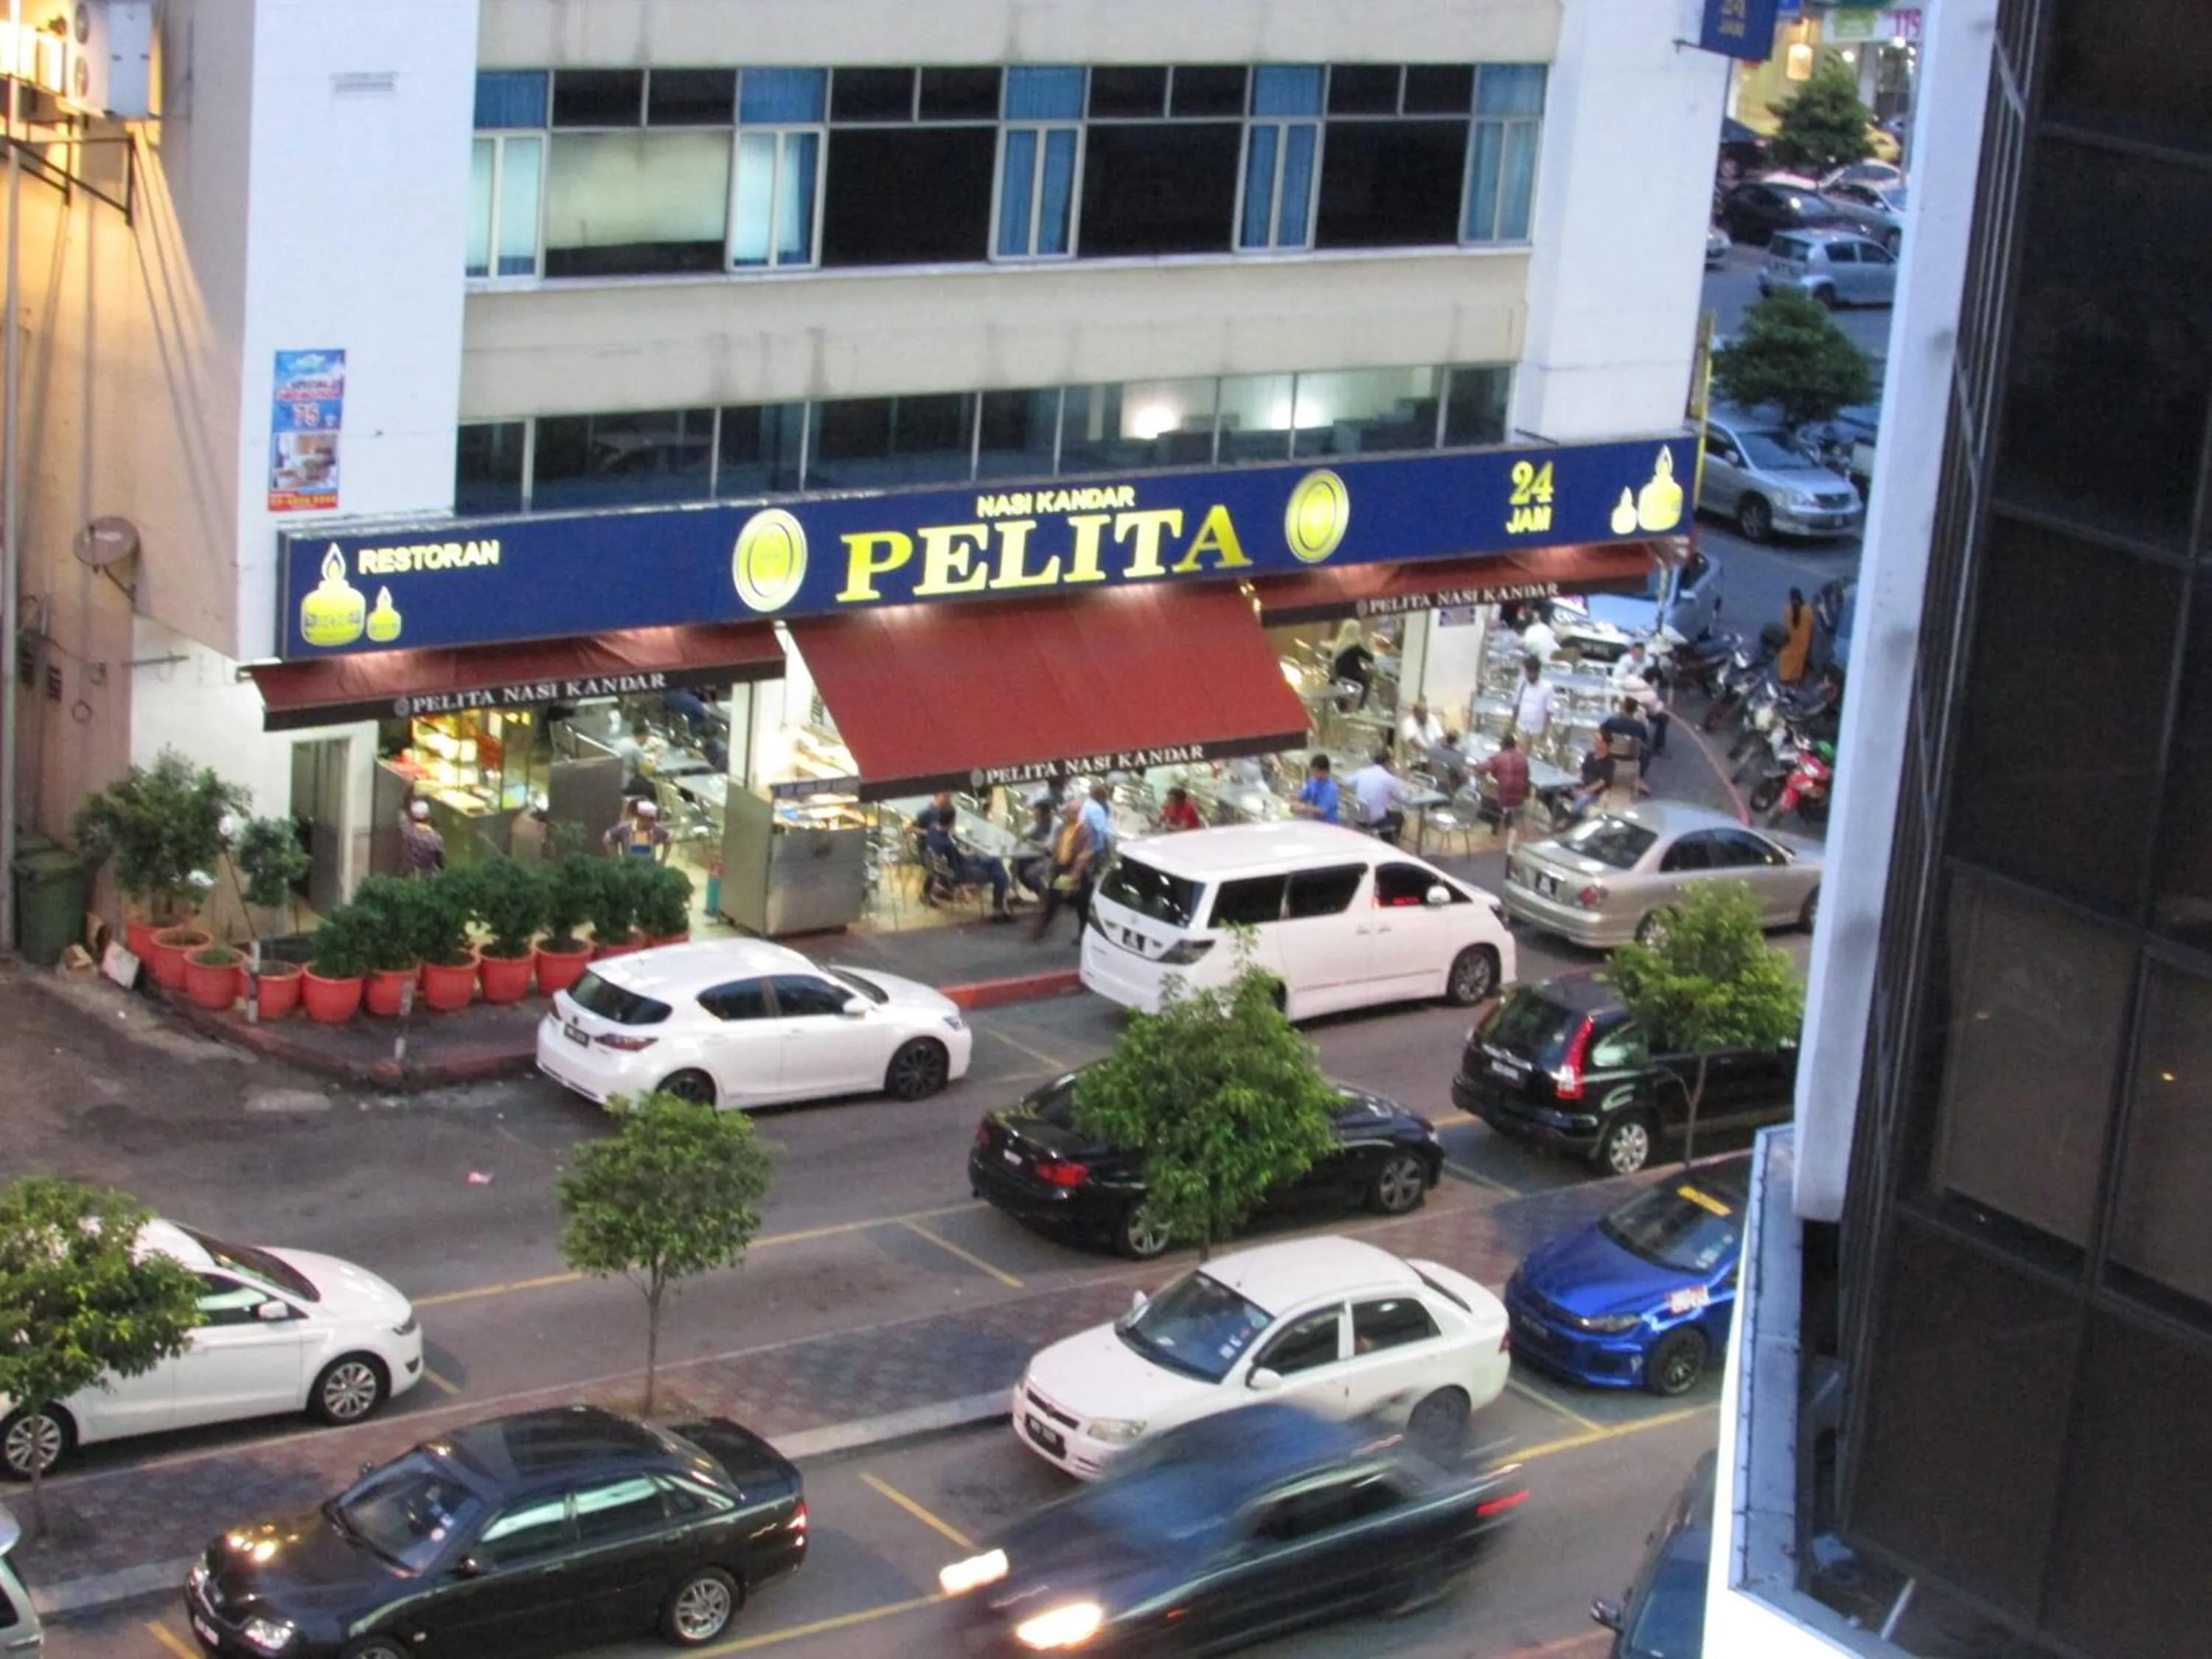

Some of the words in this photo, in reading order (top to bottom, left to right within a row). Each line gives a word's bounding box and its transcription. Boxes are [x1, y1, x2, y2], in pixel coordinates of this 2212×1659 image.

[1509, 459, 1554, 505] 24
[977, 492, 1033, 518] NASI
[1036, 485, 1135, 514] KANDAR
[1506, 504, 1552, 534] JAM
[358, 539, 501, 574] RESTORAN
[836, 504, 1252, 602] PELITA
[1369, 594, 1432, 613] PELITA
[1437, 588, 1479, 606] NASI
[1483, 582, 1559, 602] KANDAR
[412, 689, 495, 713] PELITA
[502, 681, 557, 702] NASI
[566, 671, 667, 697] KANDAR
[985, 760, 1058, 785] PELITA
[1063, 752, 1112, 776] NASI
[1117, 743, 1205, 769] KANDAR
